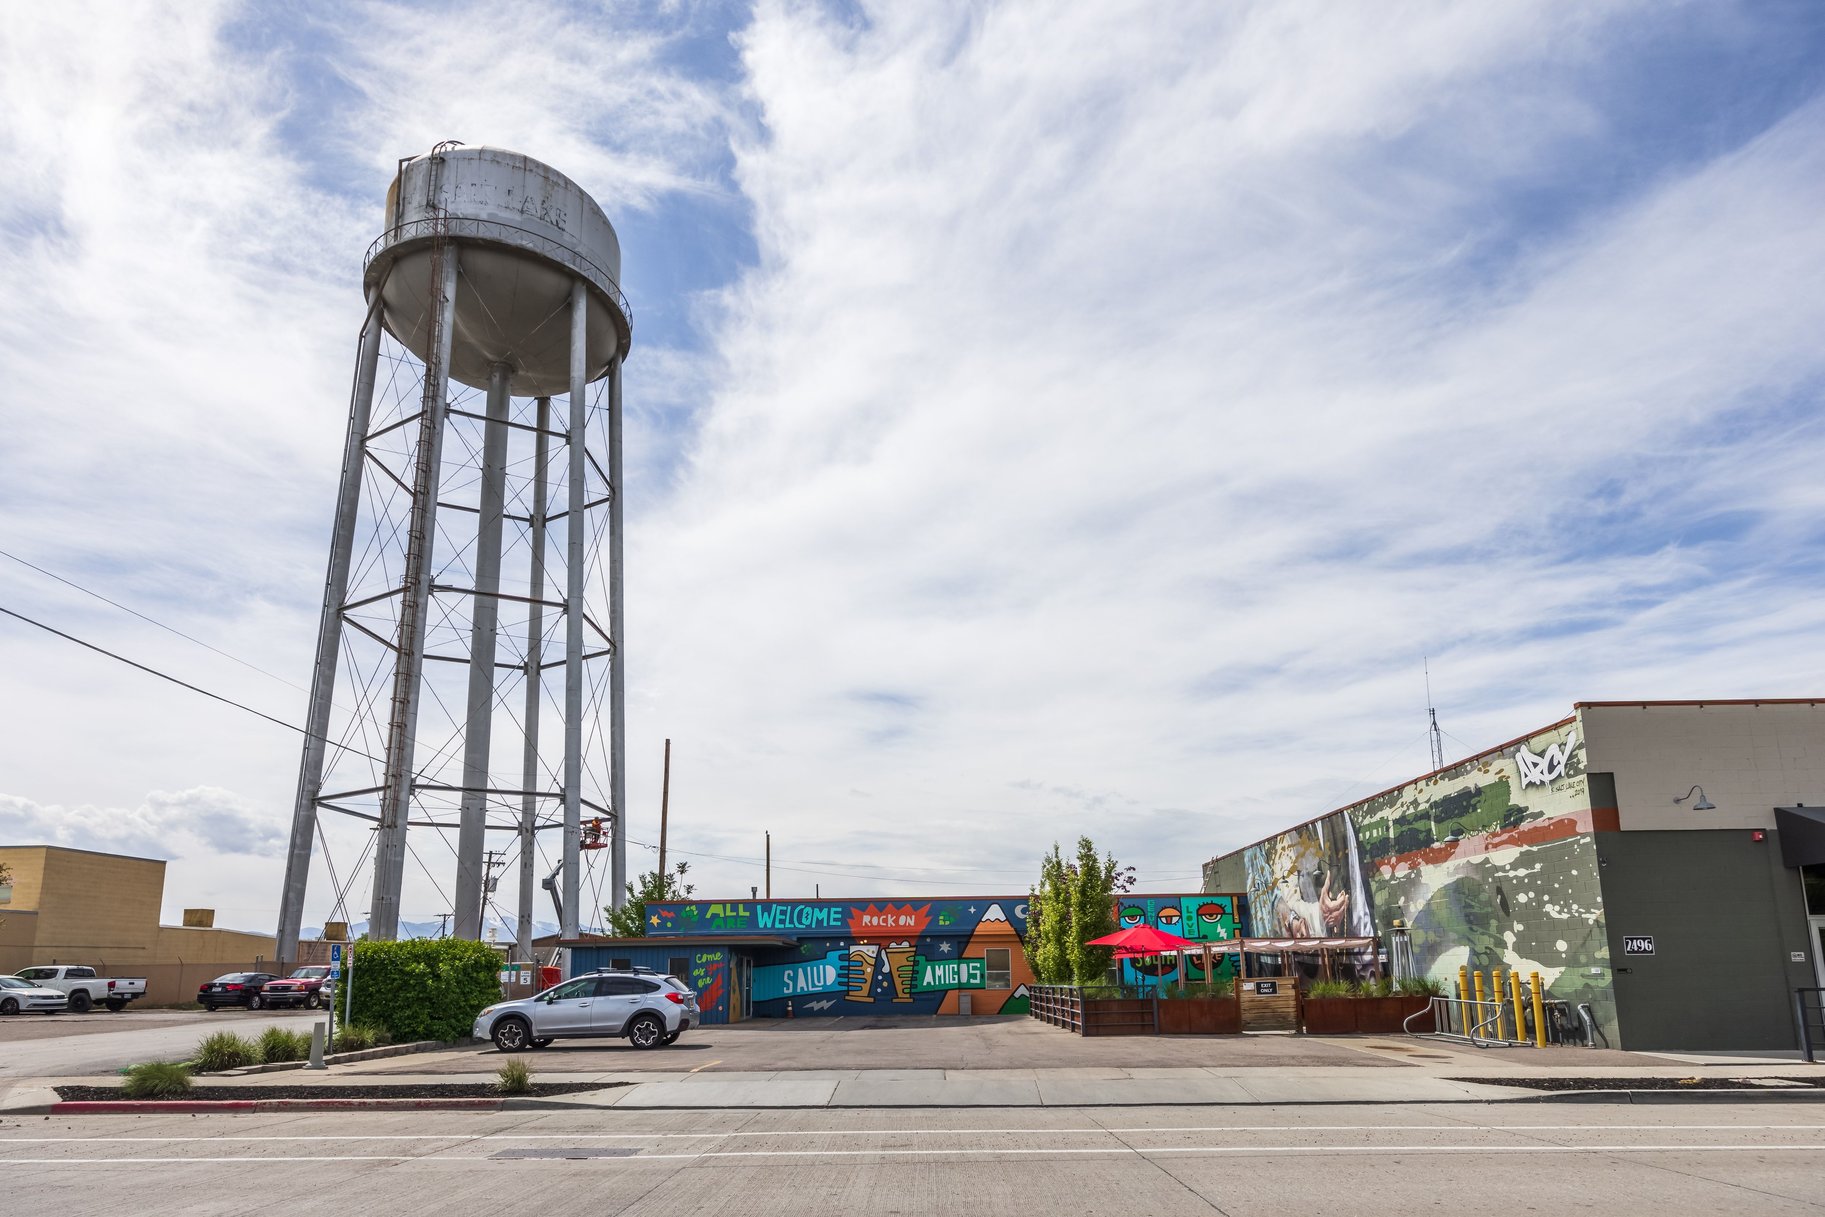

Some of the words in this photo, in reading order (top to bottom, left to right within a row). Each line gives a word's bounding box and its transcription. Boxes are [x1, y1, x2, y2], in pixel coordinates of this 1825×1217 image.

[705, 903, 750, 919] ALL
[756, 904, 843, 929] WELCOME
[862, 914, 896, 927] ROCK
[898, 915, 915, 926] ON
[1186, 905, 1196, 936] LOVE
[711, 917, 748, 929] ARE
[1625, 939, 1653, 952] 2496
[783, 964, 837, 994] SALUD
[922, 963, 982, 986] AMIGOS
